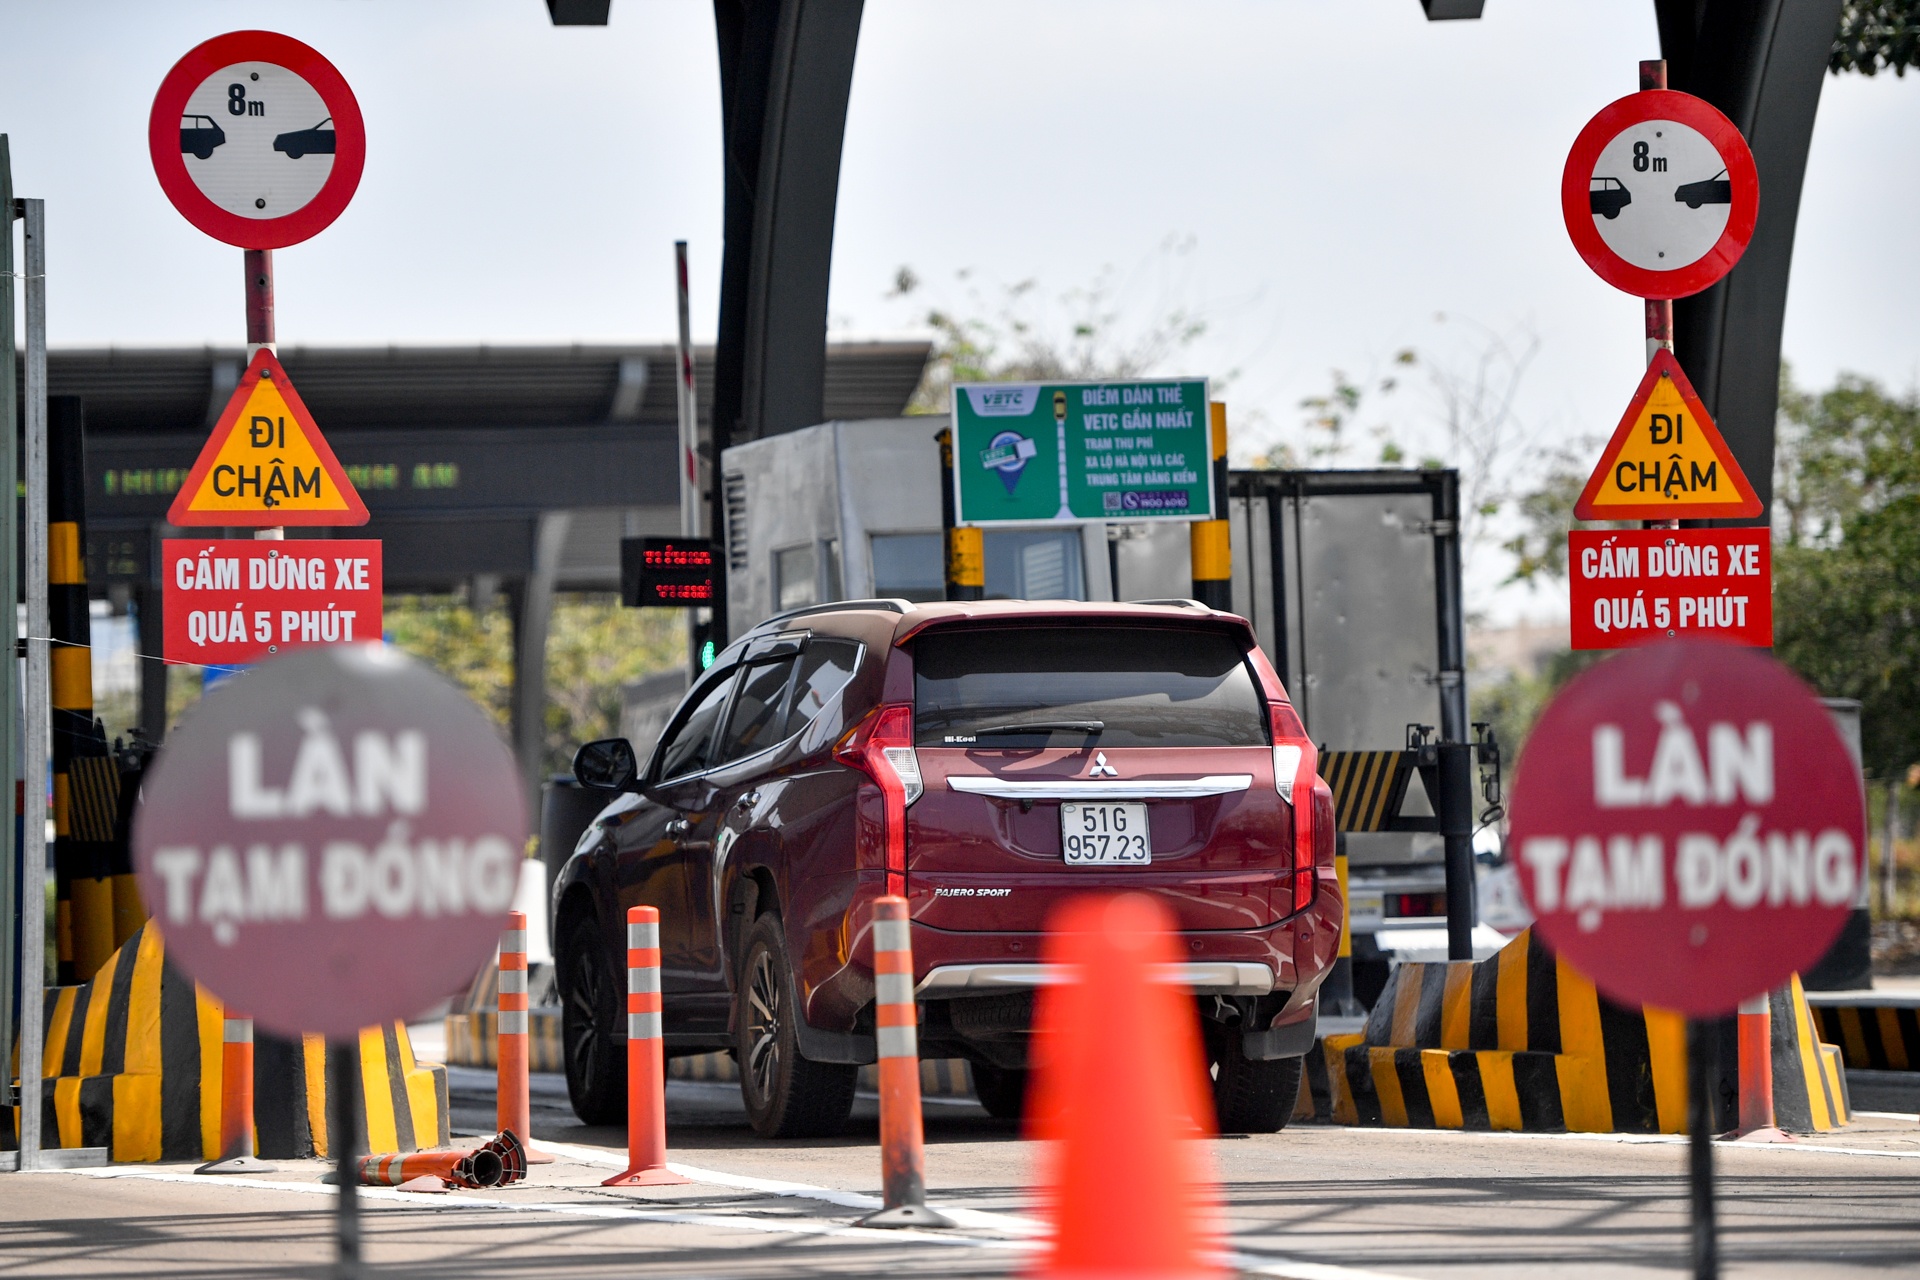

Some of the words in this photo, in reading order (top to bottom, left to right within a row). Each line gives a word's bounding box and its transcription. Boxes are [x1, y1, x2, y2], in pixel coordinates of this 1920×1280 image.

[228, 83, 265, 116] 8m
[1633, 141, 1667, 172] 8m
[983, 393, 1024, 405] VETC
[249, 416, 285, 448] ĐI
[1083, 413, 1118, 430] VETC
[1156, 405, 1194, 428] NHẤT
[1649, 414, 1682, 444] ĐI
[1114, 437, 1134, 450] THU
[213, 458, 321, 506] CHẬM
[1086, 473, 1119, 486] TRUNG
[1616, 454, 1717, 500] CHẬM
[176, 547, 240, 590] CẤM
[249, 550, 325, 590] DỪNG
[334, 558, 370, 590] XE
[1581, 536, 1640, 579] CẤM
[1648, 539, 1719, 578] DỪNG
[1727, 544, 1760, 576] XE
[188, 603, 248, 646] QUÁ
[254, 611, 272, 642] 5
[281, 603, 356, 642] PHÚT
[1594, 590, 1649, 633] QUÁ
[1654, 597, 1671, 628] 5
[1679, 588, 1749, 627] PHÚT
[228, 707, 428, 819] LÀN
[1592, 701, 1775, 807] LÀN
[1082, 807, 1127, 832] 51G
[1067, 835, 1146, 860] 957.23
[153, 842, 308, 946] TẠM
[321, 820, 514, 918] ĐÓNG
[1521, 834, 1665, 932] TẠM
[1675, 812, 1858, 910] ĐÓNG
[934, 888, 975, 897] PAJERO
[976, 888, 1012, 897] SPORT
